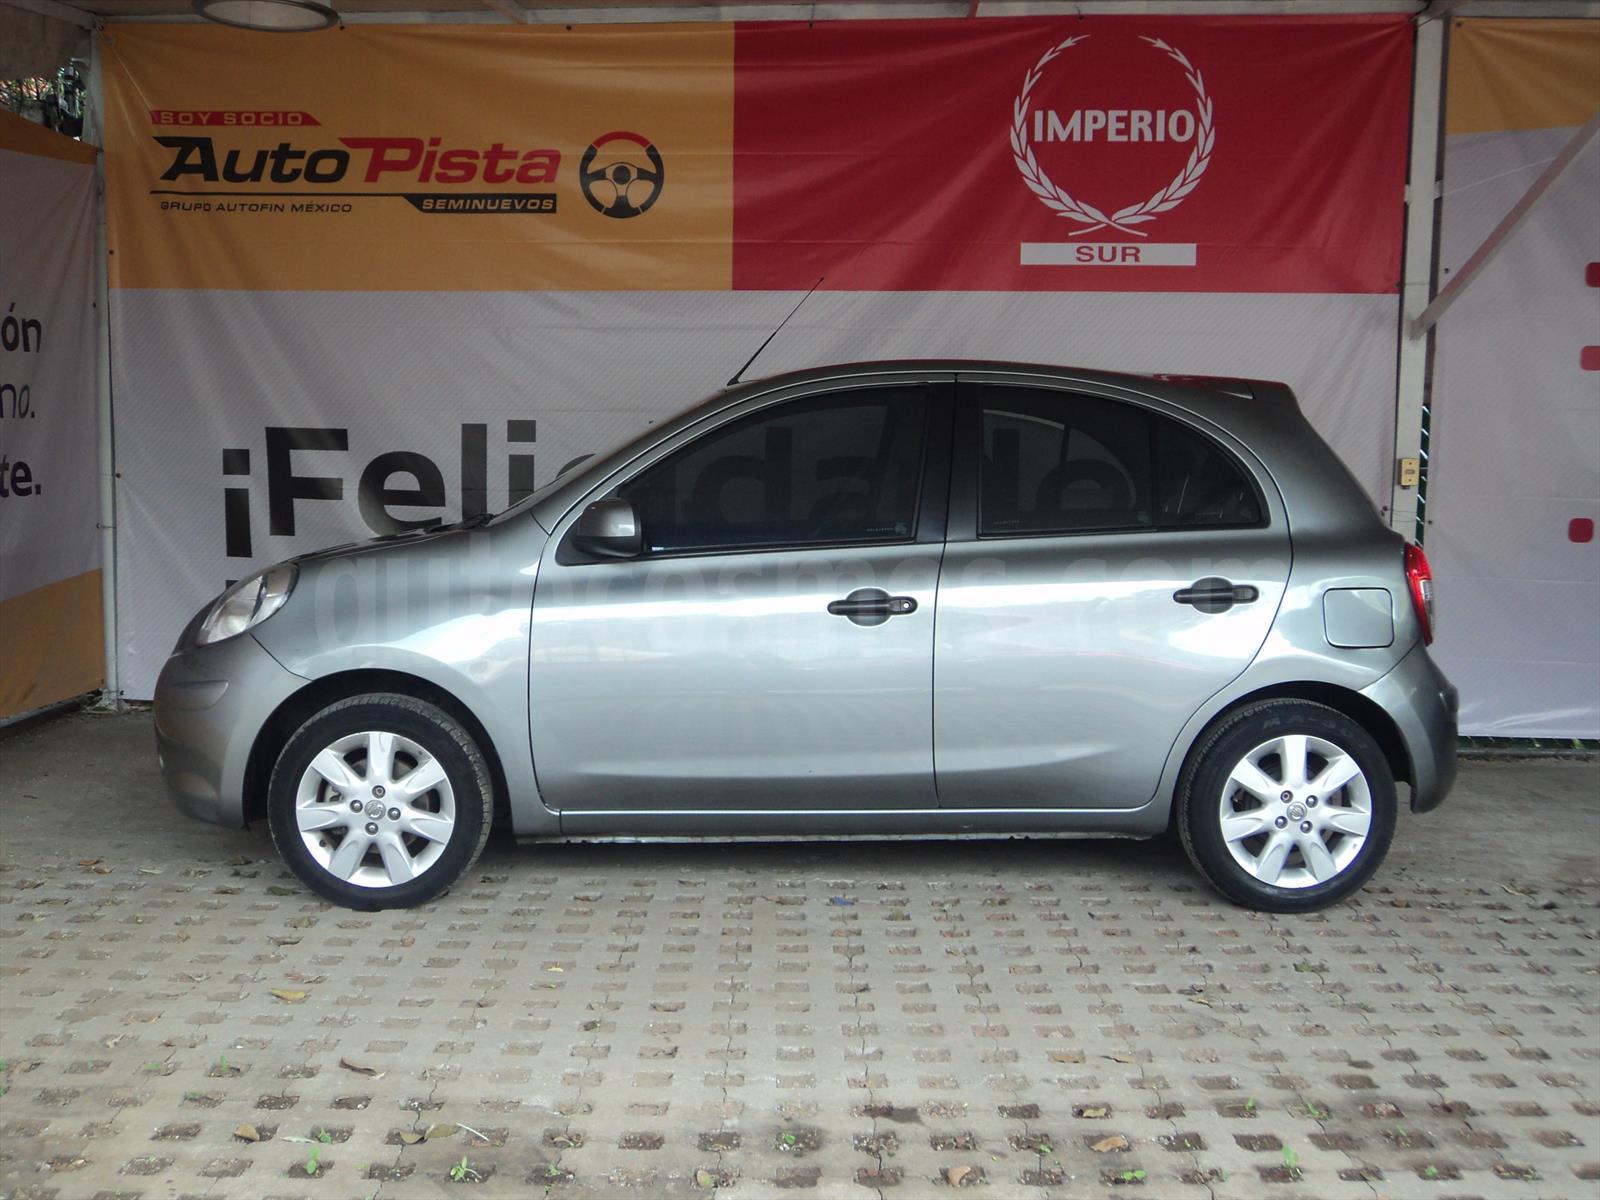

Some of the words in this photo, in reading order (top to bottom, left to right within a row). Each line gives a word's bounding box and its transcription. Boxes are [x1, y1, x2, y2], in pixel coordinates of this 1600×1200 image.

[160, 112, 214, 125] SOY
[223, 112, 303, 126] SOCIO
[1034, 110, 1195, 142] IMPERIO
[160, 202, 212, 212] GRUPO
[217, 203, 285, 213] AUTOFIN
[290, 201, 352, 213] MÉXICO
[422, 198, 555, 211] SEMINUEVOS
[1076, 246, 1141, 263] SUR
